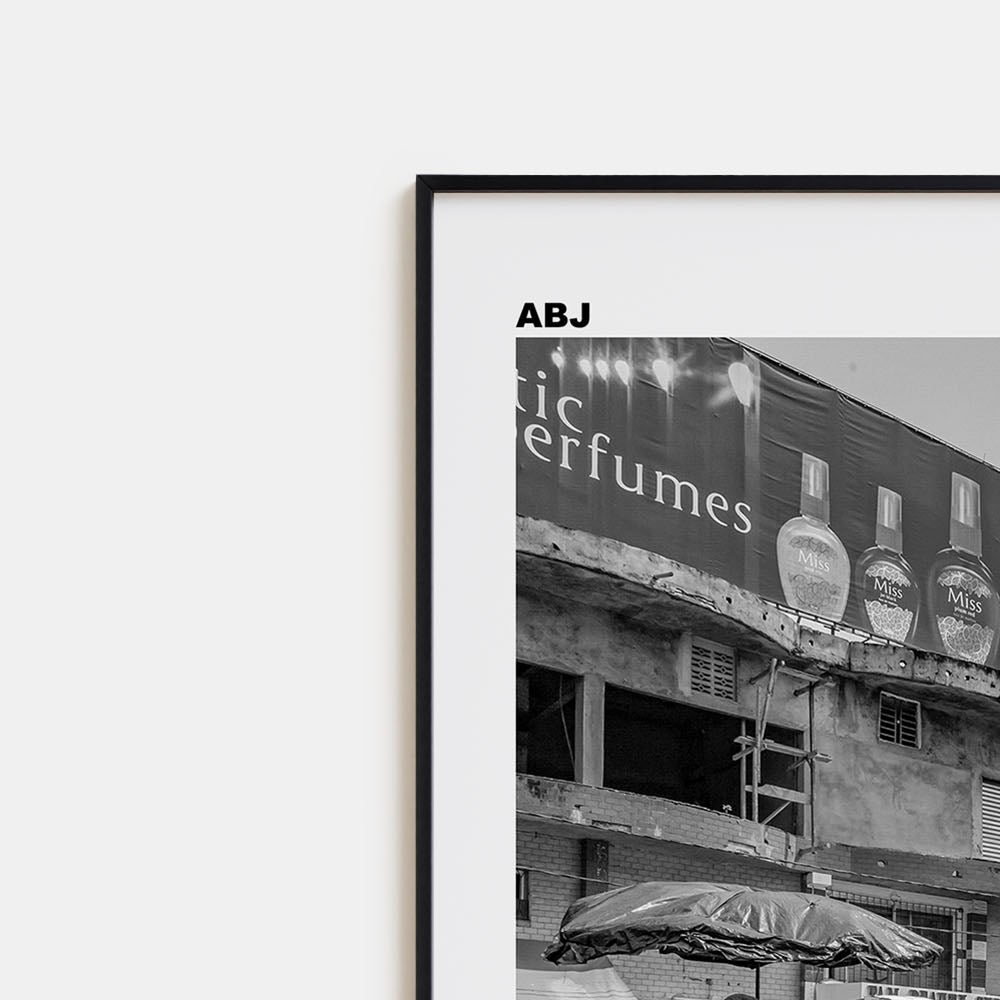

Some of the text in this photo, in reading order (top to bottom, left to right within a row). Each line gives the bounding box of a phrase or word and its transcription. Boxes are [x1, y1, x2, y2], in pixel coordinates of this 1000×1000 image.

[515, 302, 591, 329] ABJ
[516, 422, 751, 534] erfumes
[798, 549, 830, 573] Miss
[874, 577, 903, 599] Miss
[947, 587, 982, 614] Miss
